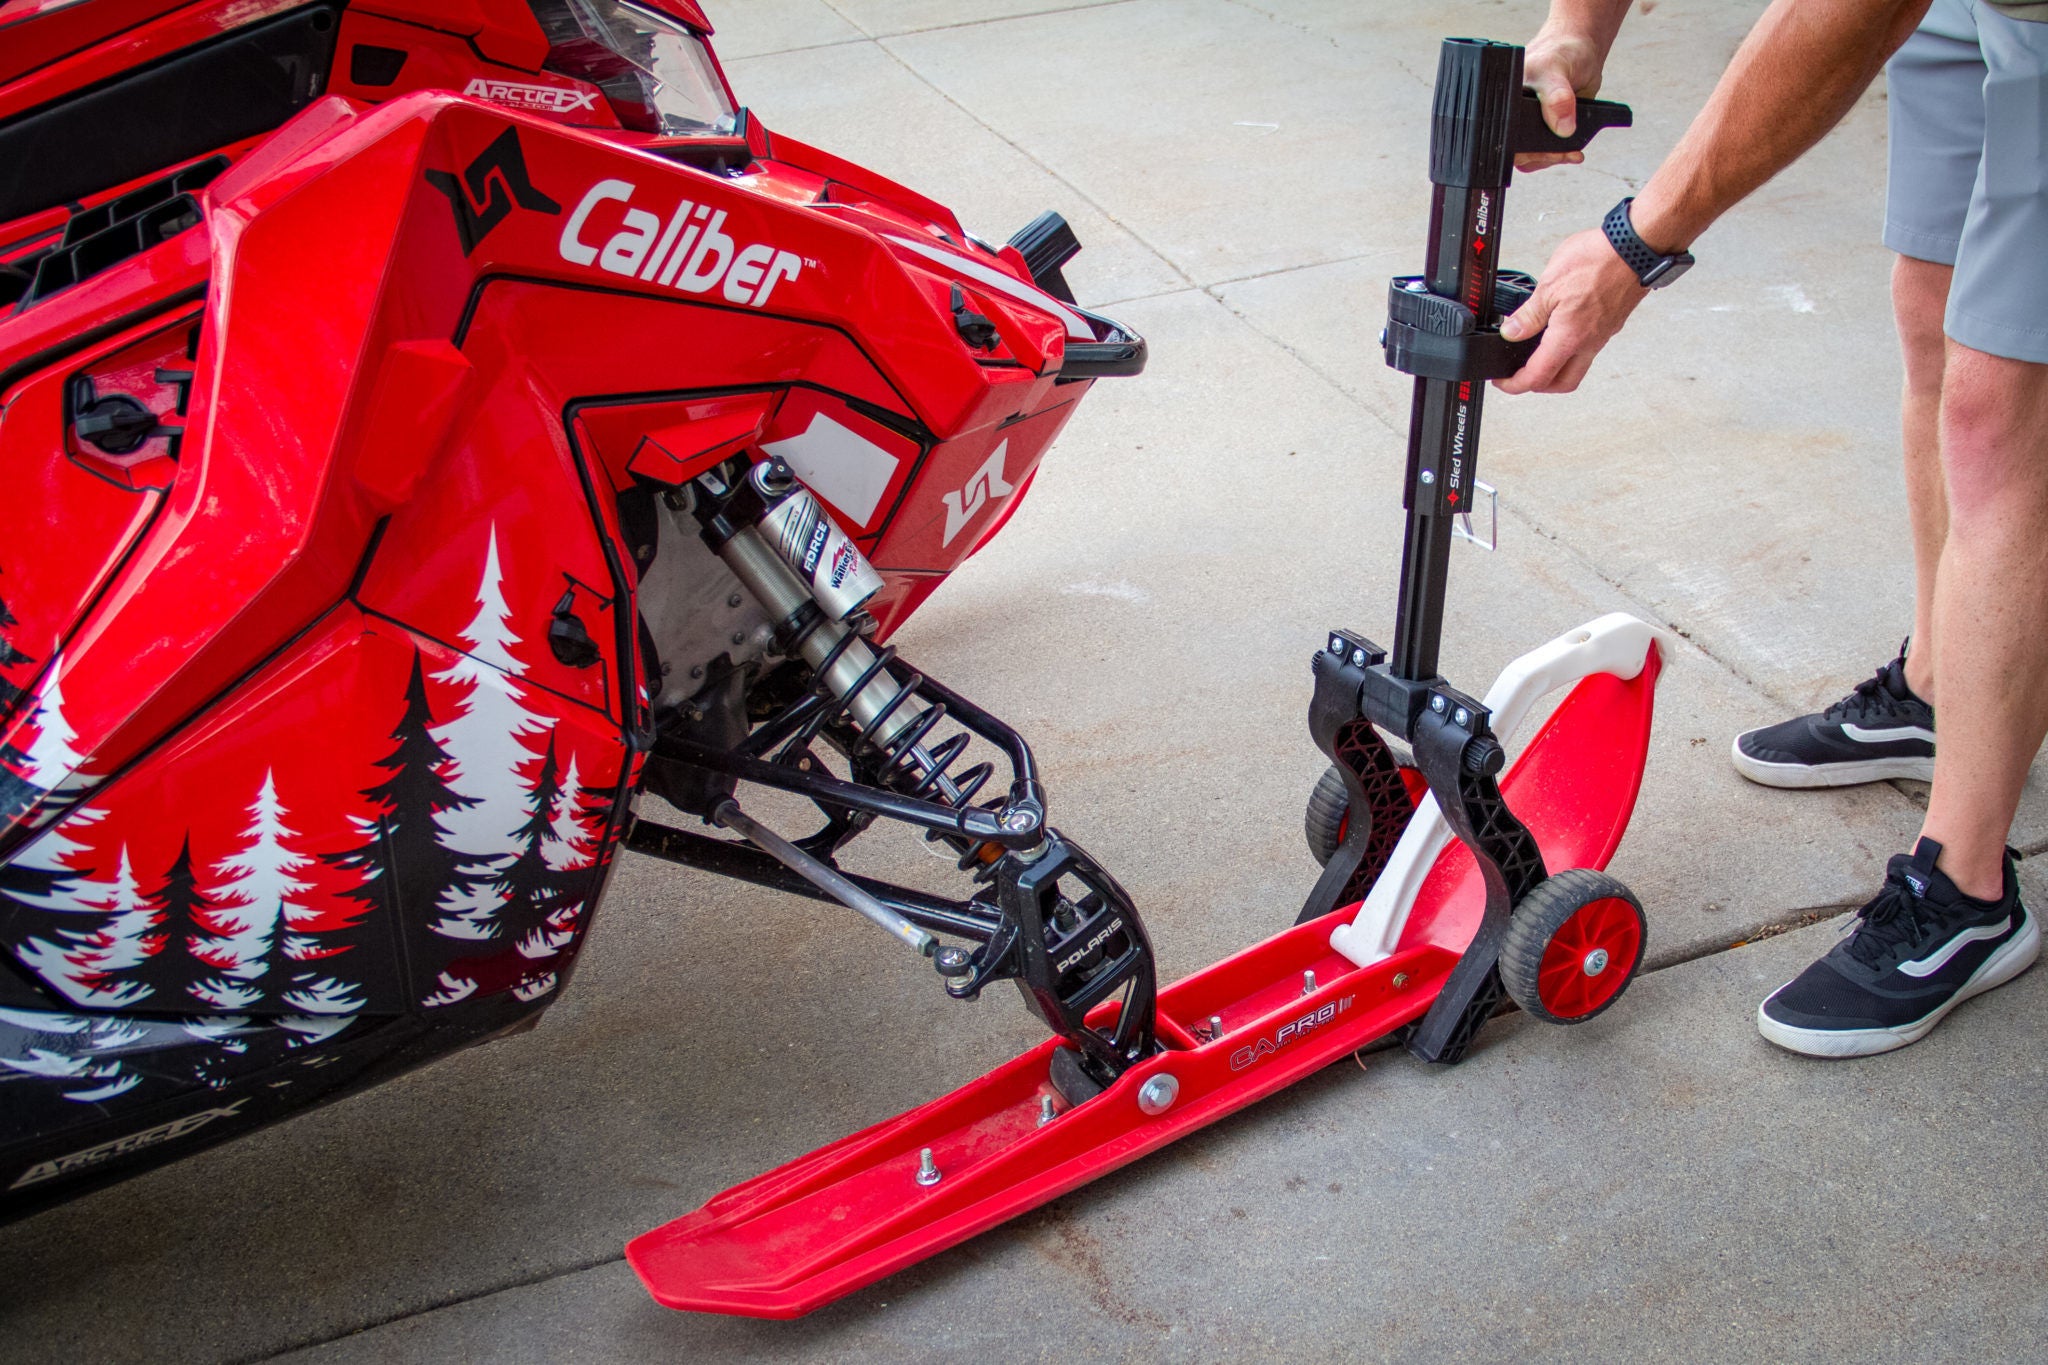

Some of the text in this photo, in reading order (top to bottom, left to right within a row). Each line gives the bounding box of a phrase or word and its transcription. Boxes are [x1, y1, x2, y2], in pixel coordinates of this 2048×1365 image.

[1475, 192, 1489, 235] Caliber
[559, 179, 801, 307] Caliber
[1450, 405, 1467, 489] Sled Wheels
[804, 521, 828, 572] FORCE
[1057, 918, 1122, 973] POLARIS
[1276, 1002, 1336, 1044] PRO
